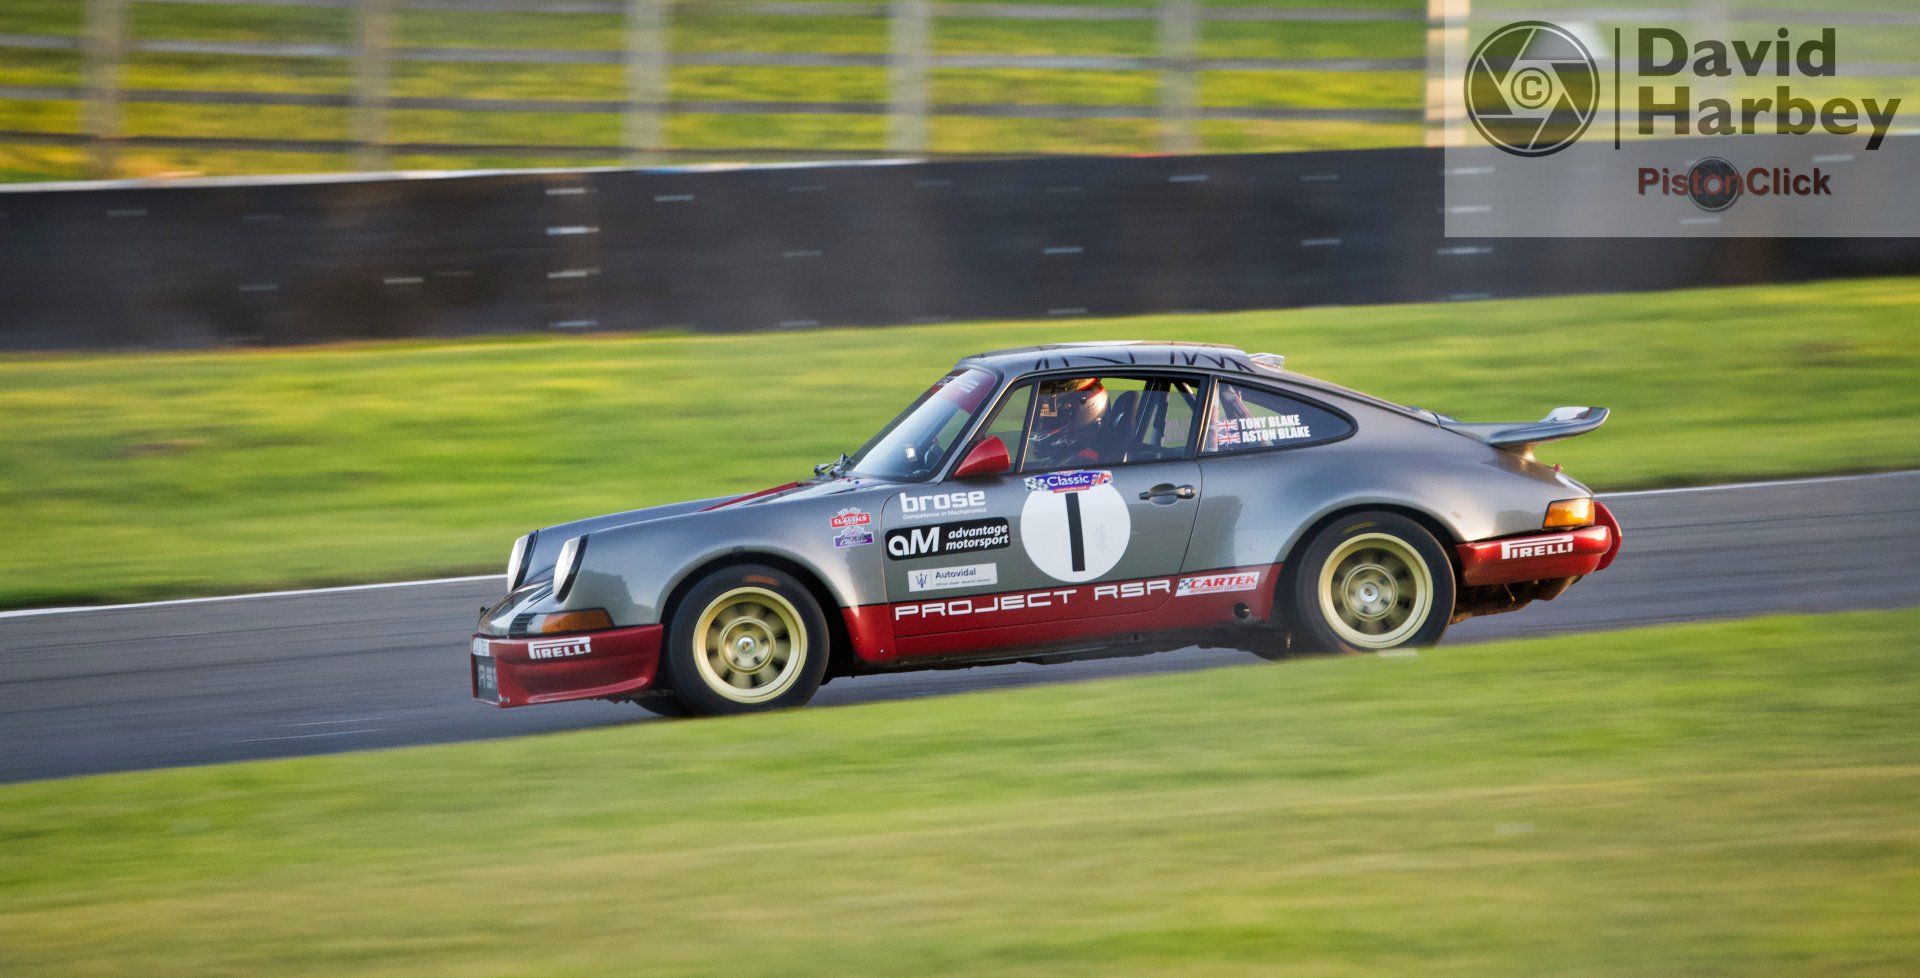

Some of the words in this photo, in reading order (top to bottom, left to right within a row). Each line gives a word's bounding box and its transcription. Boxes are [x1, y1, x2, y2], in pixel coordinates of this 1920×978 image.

[1239, 416, 1266, 430] TONY
[1267, 414, 1301, 428] BLAKE
[1242, 428, 1277, 443] ASTON
[1278, 426, 1311, 440] BLAKE
[1046, 474, 1090, 487] Classic
[899, 489, 986, 513] brose
[948, 524, 1008, 540] advantage
[888, 526, 941, 557] aM
[945, 534, 1009, 551] motorsport
[1501, 534, 1575, 560] PIRELLI
[935, 567, 977, 579] Autovidal
[1190, 575, 1257, 589] CARTEK
[895, 589, 1077, 621] PROJECT
[1094, 579, 1171, 601] RSR
[528, 636, 592, 660] PIRELLI
